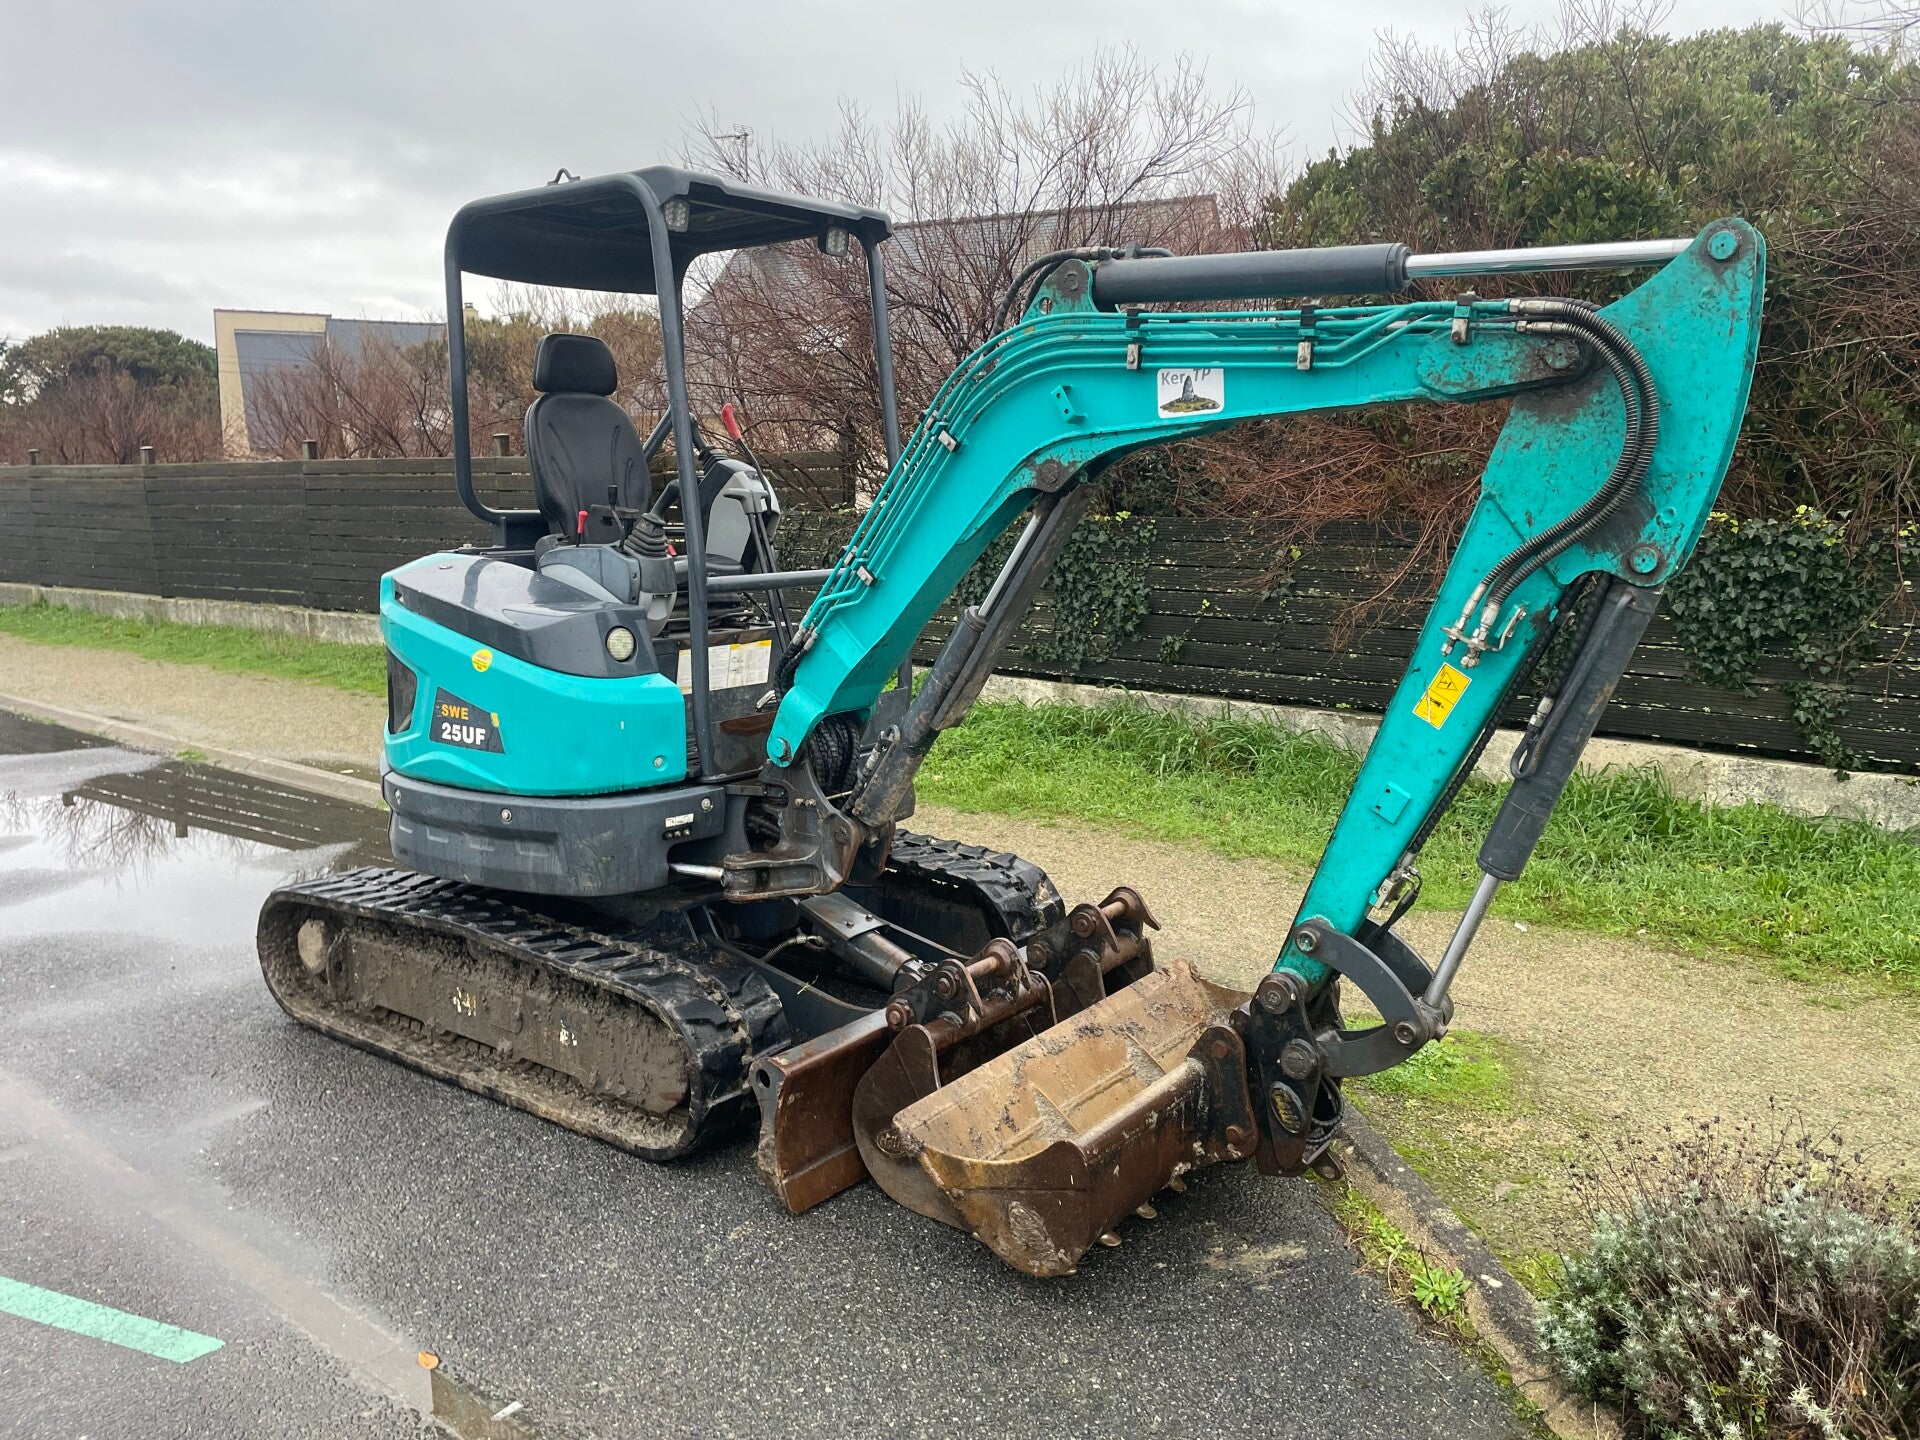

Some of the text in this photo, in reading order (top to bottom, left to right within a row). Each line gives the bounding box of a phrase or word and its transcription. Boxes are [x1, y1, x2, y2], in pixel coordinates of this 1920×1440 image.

[1161, 368, 1211, 386] Ker TP
[441, 703, 469, 720] SWE
[441, 722, 486, 745] 25UF
